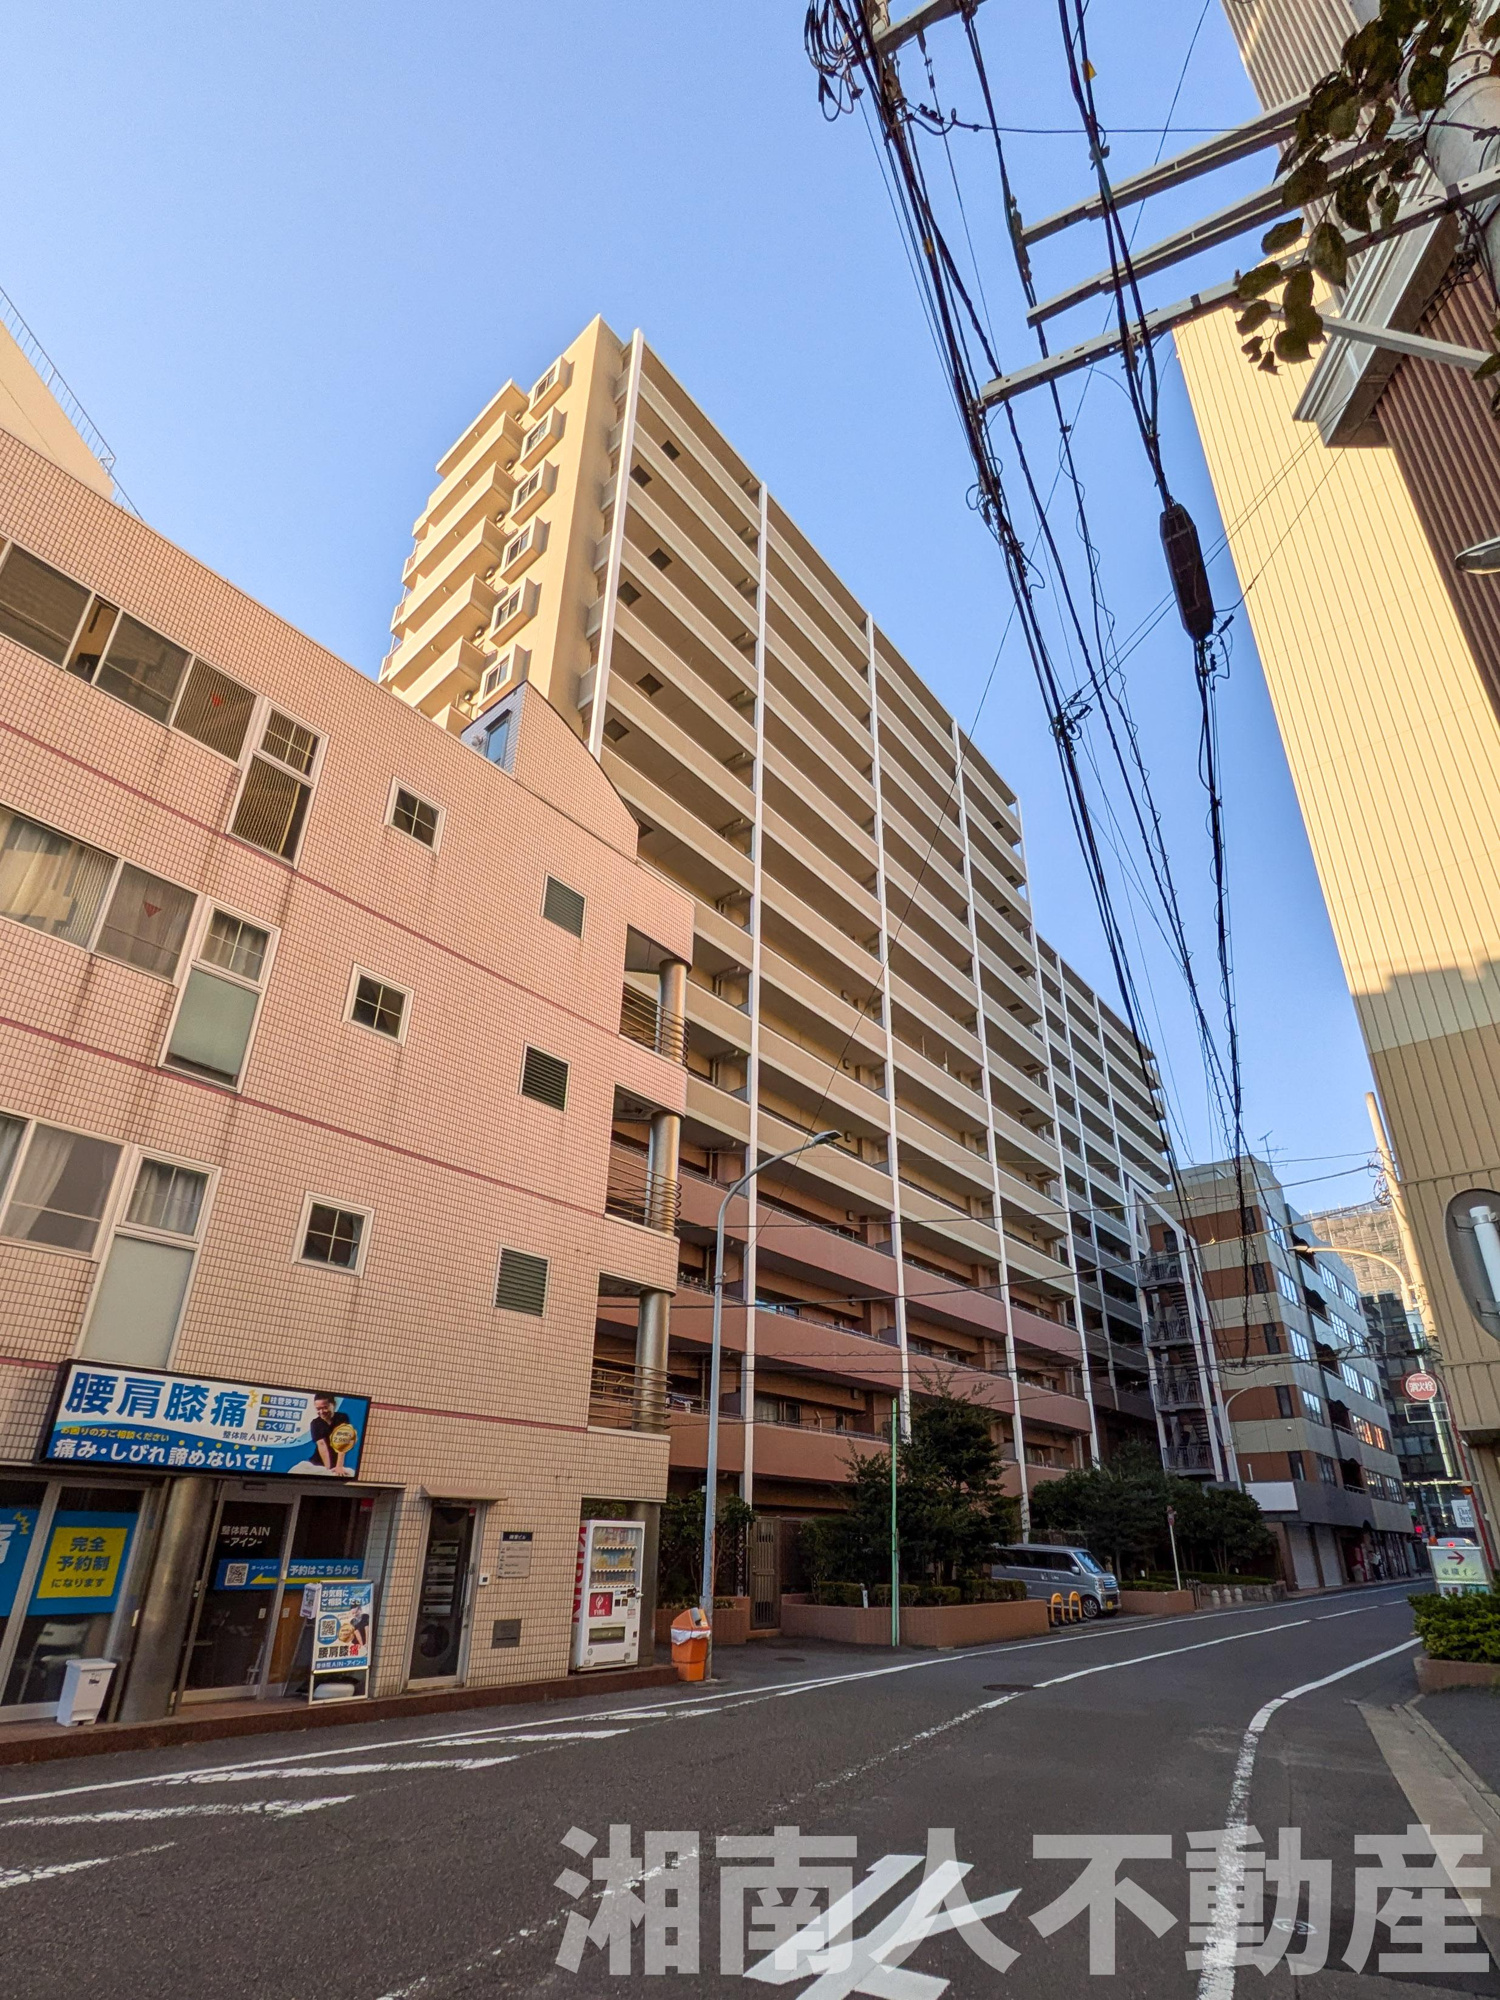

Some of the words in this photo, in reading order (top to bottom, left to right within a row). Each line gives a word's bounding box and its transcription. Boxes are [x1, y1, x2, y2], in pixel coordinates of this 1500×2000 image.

[1408, 1381, 1435, 1393] 消火栓
[65, 1372, 250, 1428] 腰肩膝痛
[60, 1426, 170, 1442] お困りの方ご相談ください
[69, 1536, 107, 1552] 完全
[57, 1555, 111, 1572] 予約制
[289, 1564, 359, 1577] 予約はこちらから
[51, 1578, 105, 1588] になります
[321, 1589, 349, 1598] お気軽に
[321, 1598, 369, 1607] ご相談ください
[318, 1644, 359, 1659] 腰肩膝痛
